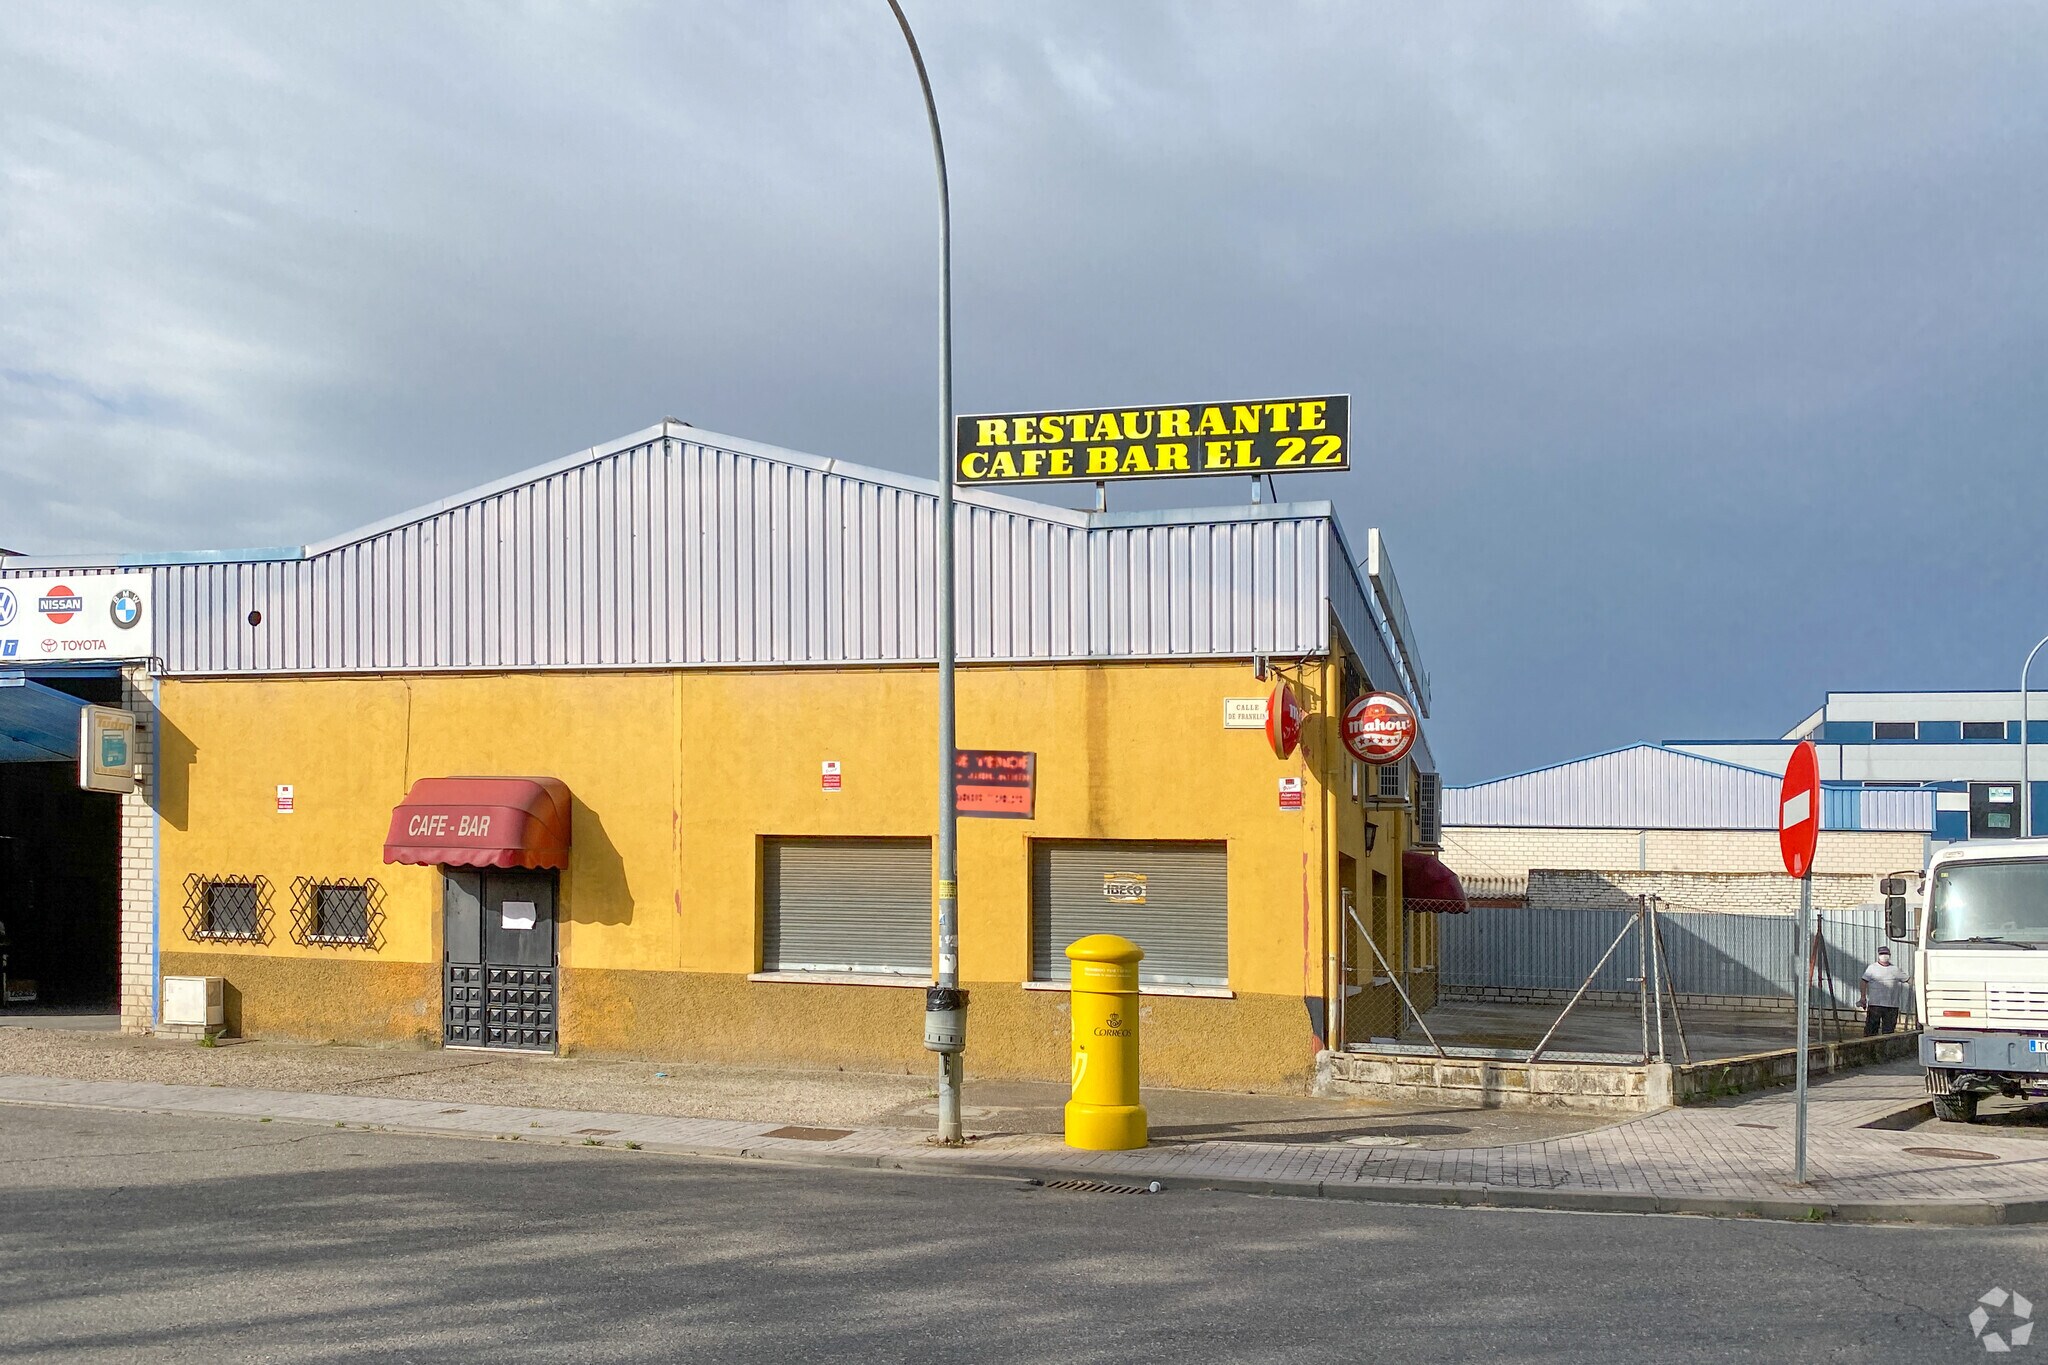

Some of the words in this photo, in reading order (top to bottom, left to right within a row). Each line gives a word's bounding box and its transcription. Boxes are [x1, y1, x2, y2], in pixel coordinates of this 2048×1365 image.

[976, 401, 1326, 447] RESTAURANTE
[961, 449, 1073, 479] CAFE
[1086, 443, 1190, 474] BAR
[1204, 440, 1261, 469] EL
[1275, 435, 1342, 466] 22
[40, 599, 81, 610] NISSAN
[61, 640, 107, 651] TOYOTA
[408, 815, 448, 836] CAFE
[457, 815, 490, 837] BAR
[1094, 1027, 1132, 1037] CORREOS
